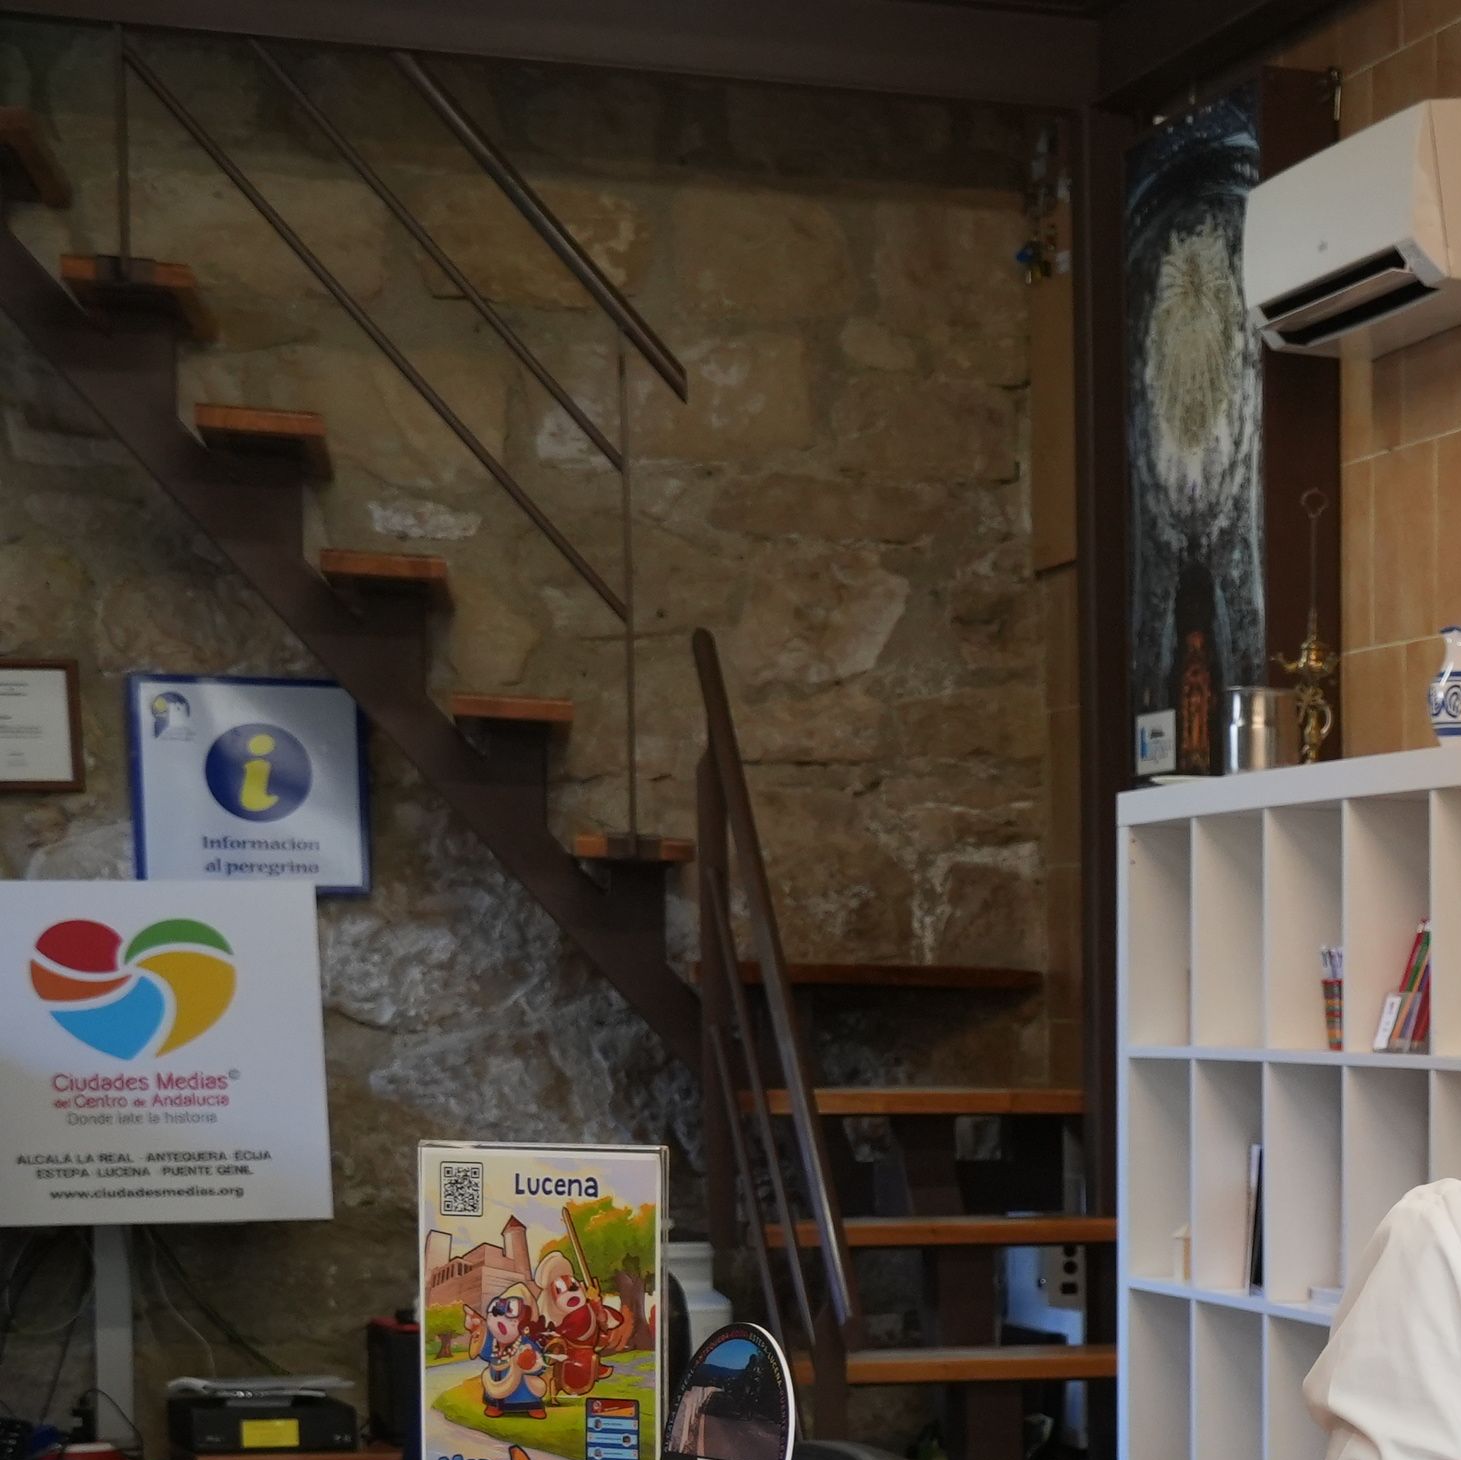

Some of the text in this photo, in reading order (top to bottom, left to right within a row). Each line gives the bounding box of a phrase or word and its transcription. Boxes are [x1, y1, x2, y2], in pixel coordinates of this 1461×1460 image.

[205, 857, 221, 874] al
[53, 1072, 149, 1092] Ciudades
[74, 1094, 128, 1109] Centro
[96, 1166, 151, 1178] LUCENA
[49, 1185, 245, 1200] www.ciudadesmedias.org
[513, 1171, 601, 1199] Lucena
